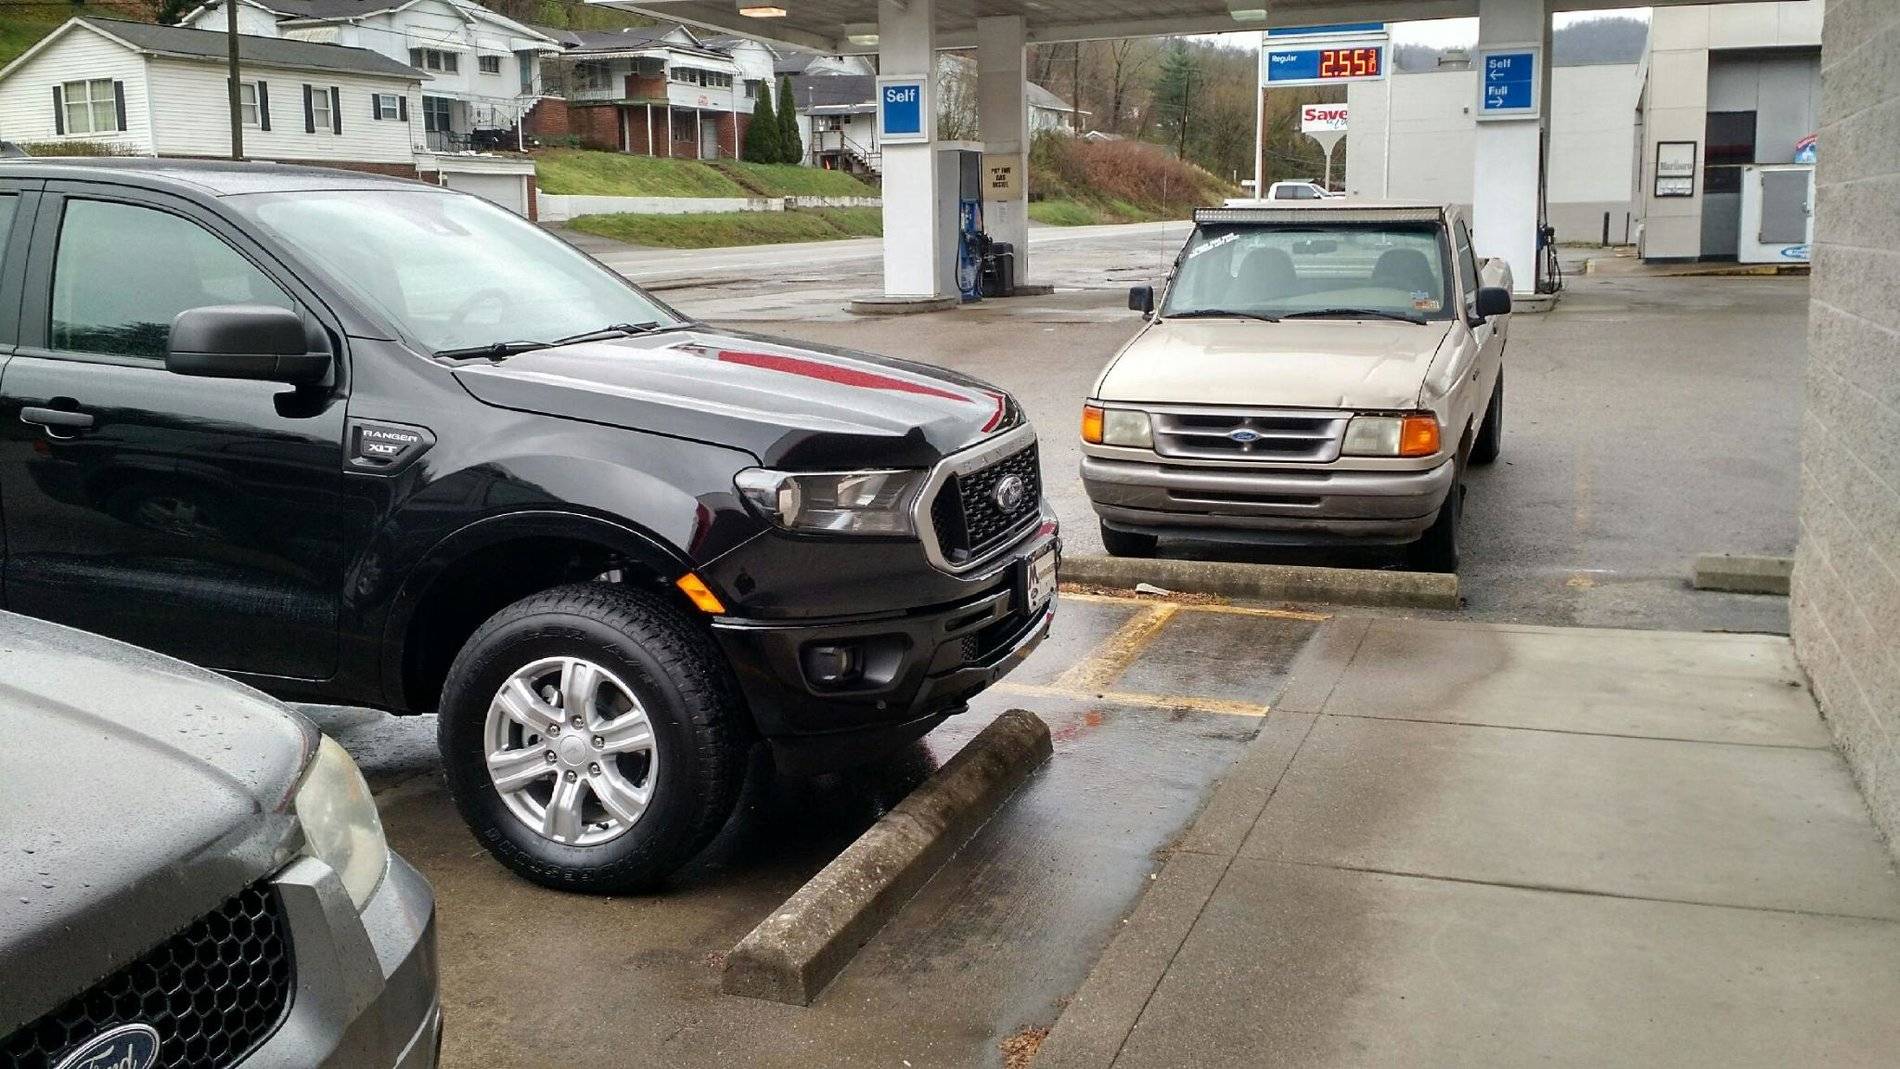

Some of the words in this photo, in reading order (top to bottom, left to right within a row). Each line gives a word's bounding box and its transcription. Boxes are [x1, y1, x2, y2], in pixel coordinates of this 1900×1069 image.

[1271, 54, 1298, 64] Regular
[1322, 50, 1366, 76] 2.55
[1489, 59, 1511, 69] Self
[886, 89, 915, 103] Self
[1488, 86, 1508, 96] Full
[1304, 108, 1348, 121] Save
[363, 429, 418, 442] RANGER
[368, 444, 397, 453] XLT
